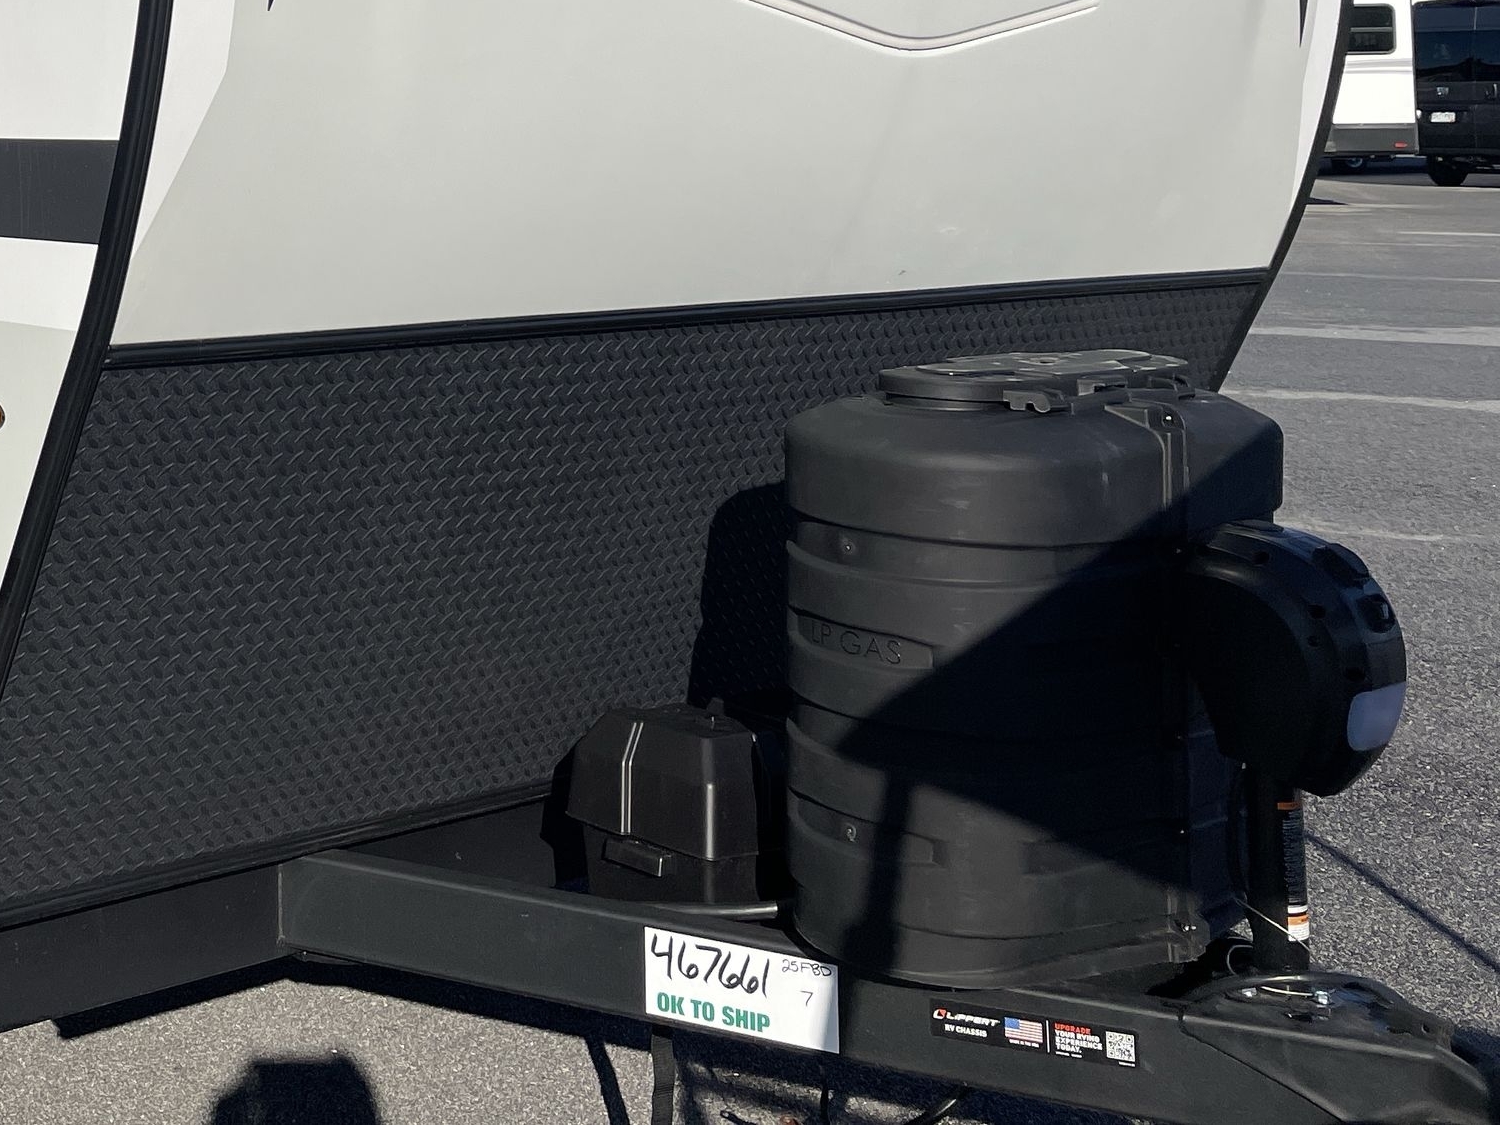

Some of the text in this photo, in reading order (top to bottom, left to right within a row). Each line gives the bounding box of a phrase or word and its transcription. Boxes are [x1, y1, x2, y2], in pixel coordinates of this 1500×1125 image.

[812, 622, 901, 665] LP GAS
[651, 932, 770, 999] 467661
[657, 992, 771, 1033] OK TO SHIP
[946, 1011, 999, 1027] LIPPERT
[944, 1023, 988, 1038] RV CHASSIS
[1054, 1022, 1091, 1035] UPGRADE
[1055, 1029, 1076, 1040] YOUR
[1055, 1036, 1103, 1051] EXPERIENCE
